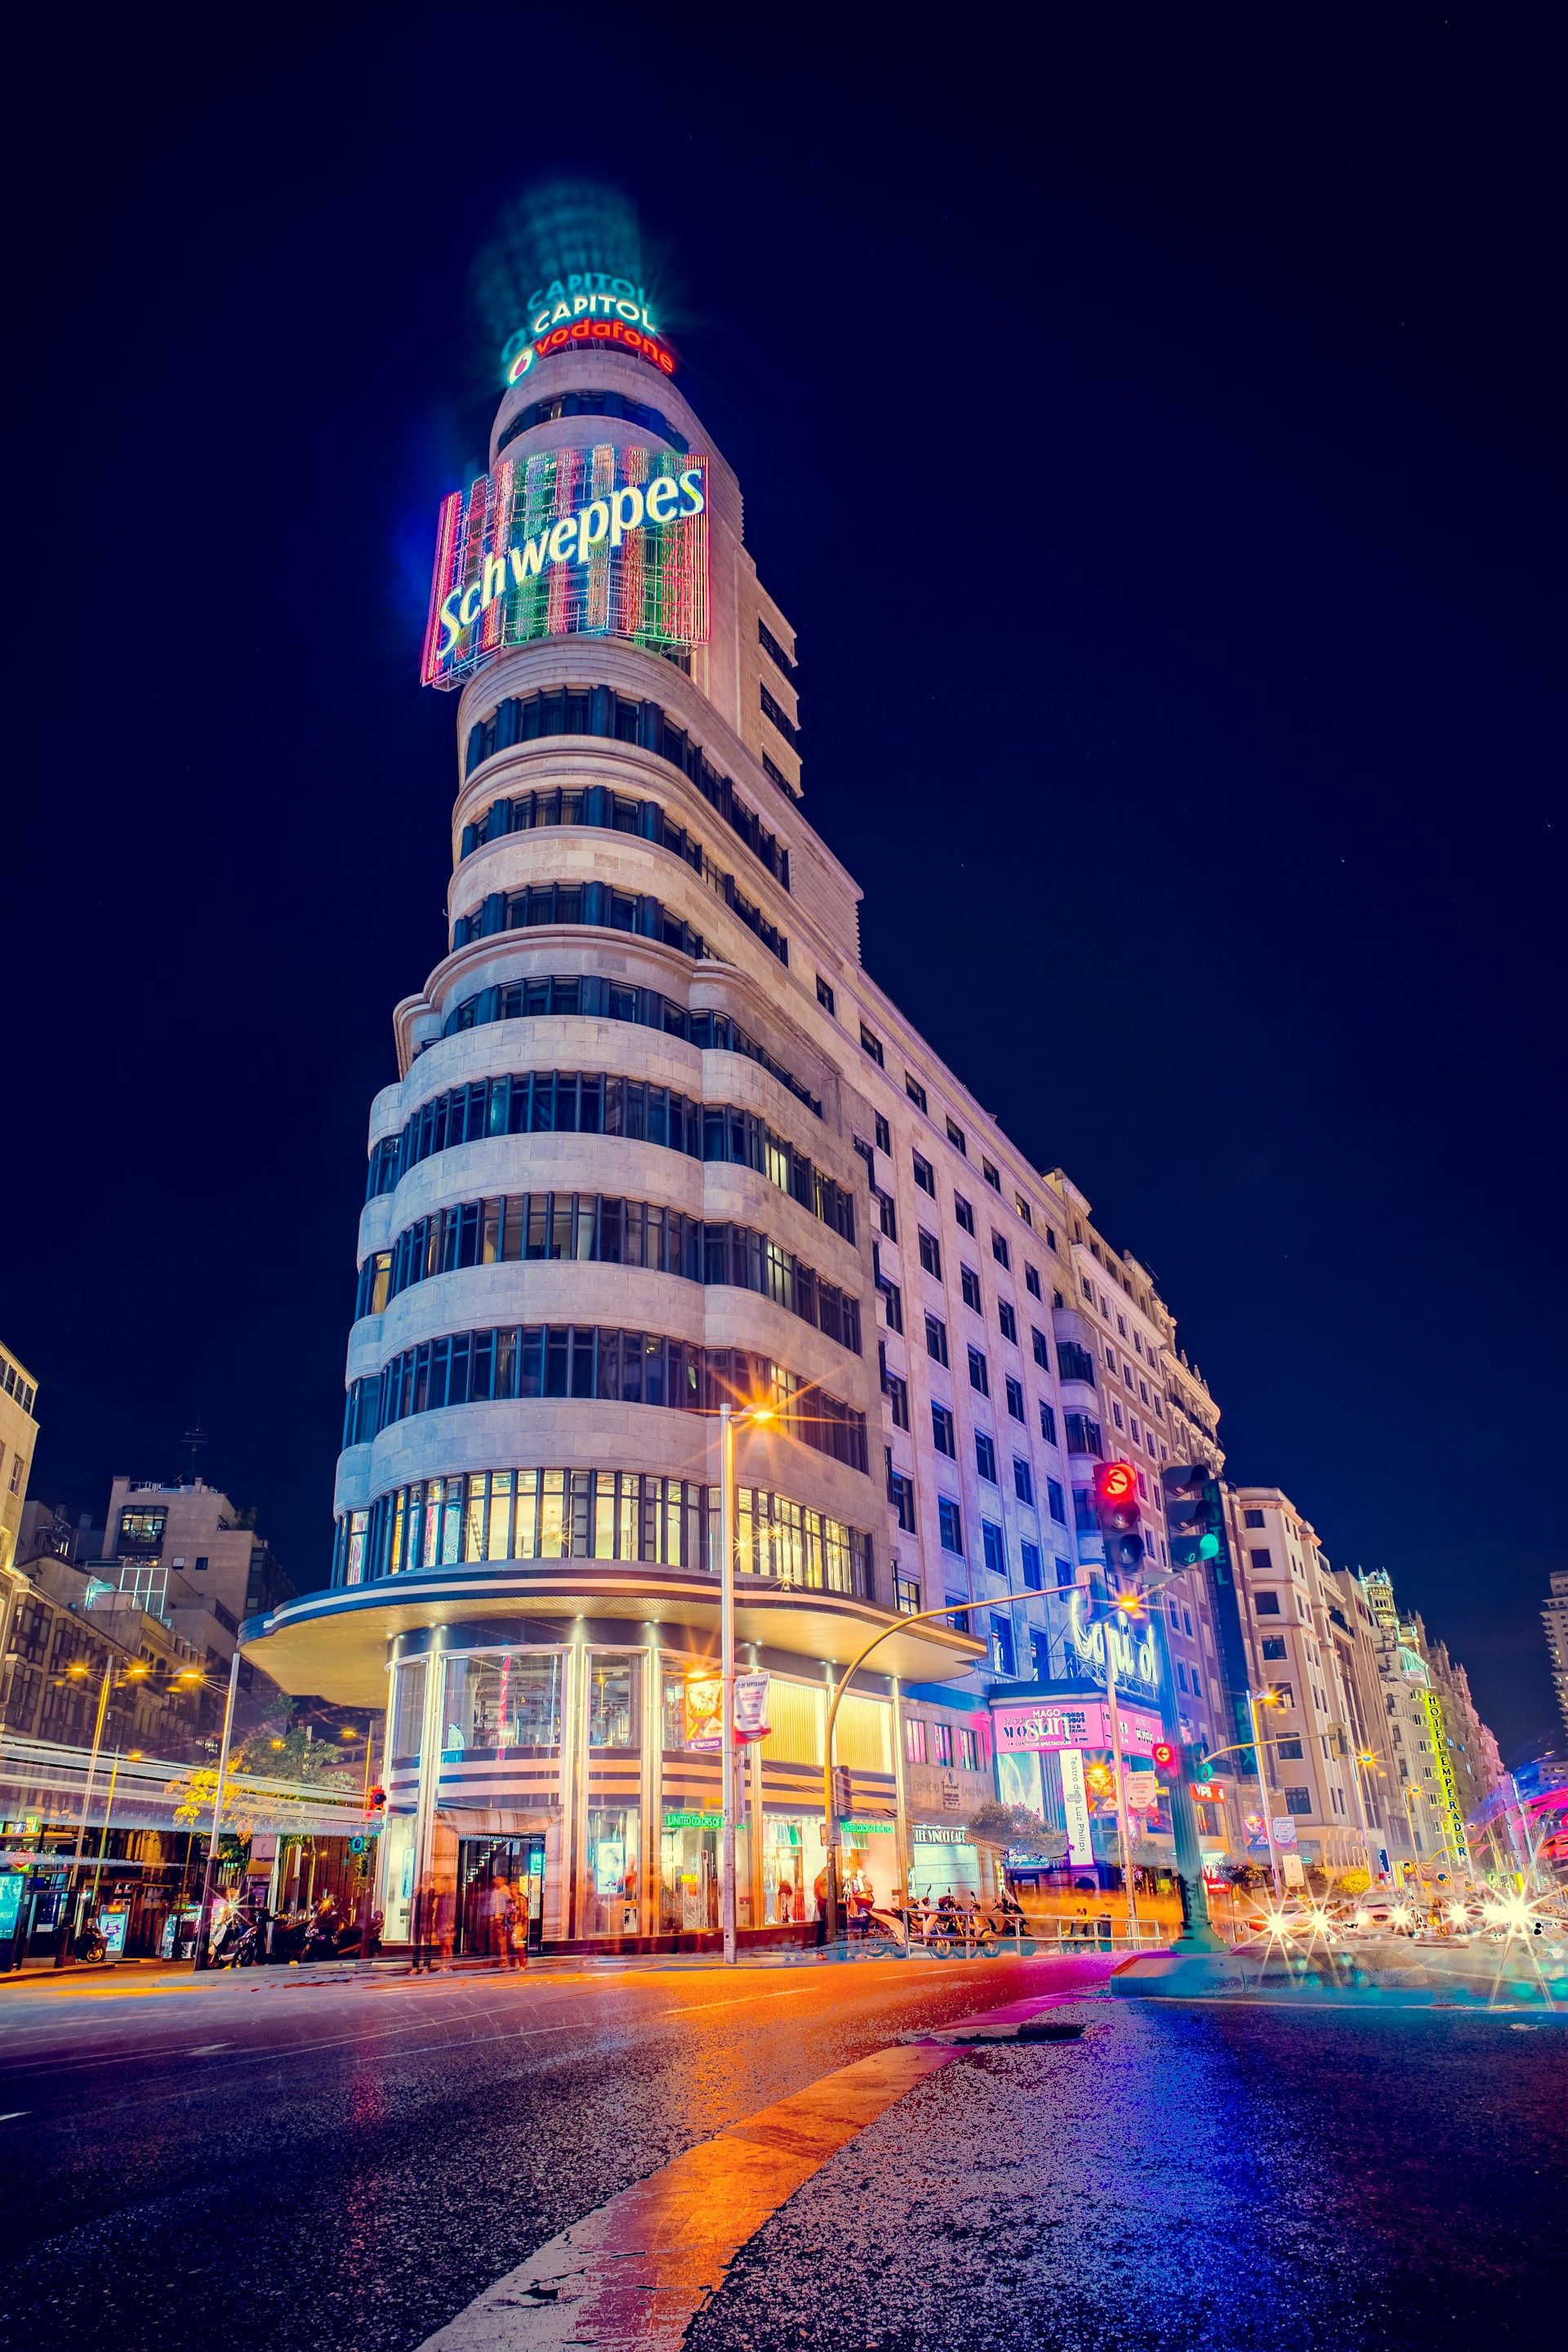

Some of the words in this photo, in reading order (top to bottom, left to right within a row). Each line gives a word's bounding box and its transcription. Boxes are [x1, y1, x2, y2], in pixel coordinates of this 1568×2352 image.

[533, 295, 656, 333] CAPITOL
[535, 318, 672, 373] vodafone
[436, 467, 705, 660] Schweppes
[1025, 1716, 1071, 1742] sun
[1032, 1708, 1061, 1718] MAGO
[1428, 1696, 1446, 1750] HOTEL
[1441, 1757, 1467, 1857] EMPERADOR
[667, 1815, 692, 1826] UNITED
[692, 1815, 713, 1826] COLORS
[713, 1817, 720, 1826] OF
